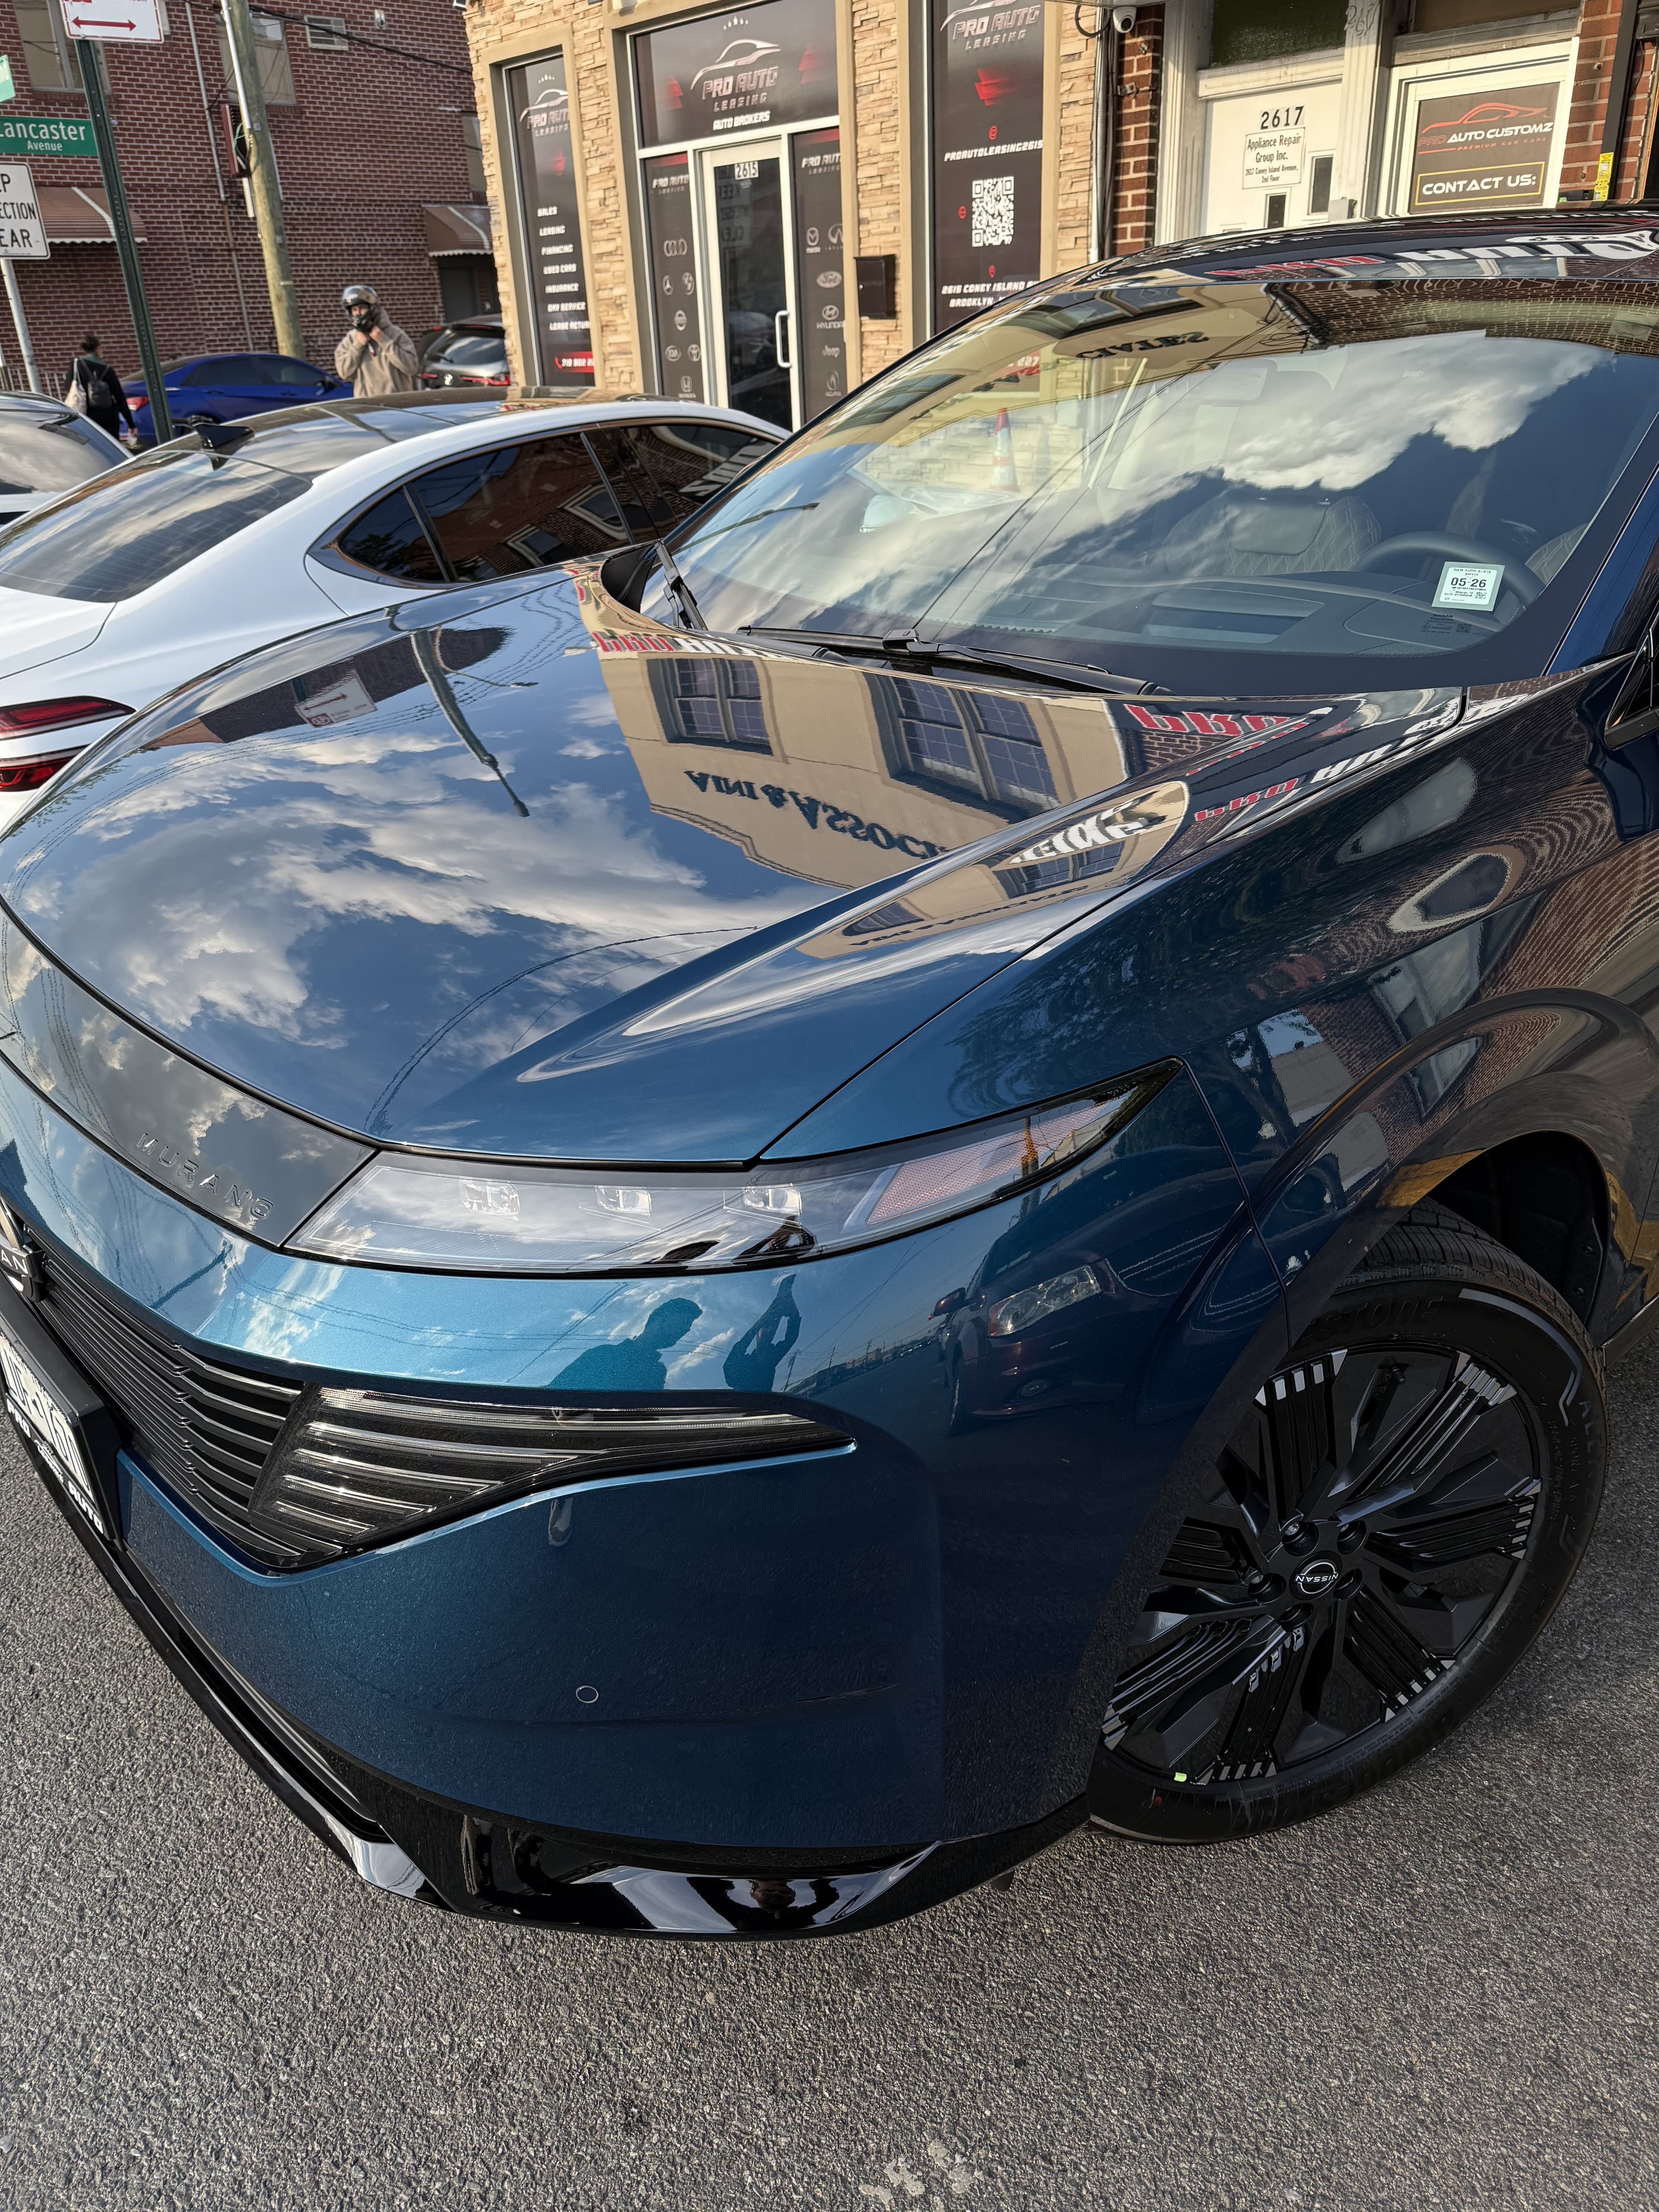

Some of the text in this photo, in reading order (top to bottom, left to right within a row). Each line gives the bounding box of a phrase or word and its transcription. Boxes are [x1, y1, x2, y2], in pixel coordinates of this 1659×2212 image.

[953, 5, 1041, 40] PRO AUTO
[965, 30, 1027, 51] LEASING
[702, 66, 779, 100] PRO AUTO
[714, 92, 767, 112] LEASING
[527, 108, 569, 129] PRO AUT
[713, 110, 770, 130] AUTO BROKERS
[1261, 106, 1304, 130] 2617
[1247, 133, 1302, 152] Appliance Repair
[1417, 122, 1554, 146] PRO AUTO CUSTOMZ
[27, 141, 63, 152] Avenue
[944, 140, 1044, 162] PROAUTOLEASING2615
[1255, 150, 1288, 163] Group Inc.
[1457, 143, 1497, 151] PREMIUM
[736, 162, 757, 178] 2615
[801, 153, 840, 168] PRO AUT
[0, 173, 11, 193] P
[652, 177, 668, 189] PRO
[1422, 174, 1536, 195] CONTACT US:
[963, 283, 992, 293] CONEY
[992, 281, 1025, 292] ISLAND
[136, 1132, 274, 1220] MURANO
[6, 1398, 31, 1439] PRO
[67, 1480, 104, 1535] AUTO
[1296, 1573, 1338, 1582] NISSAN
